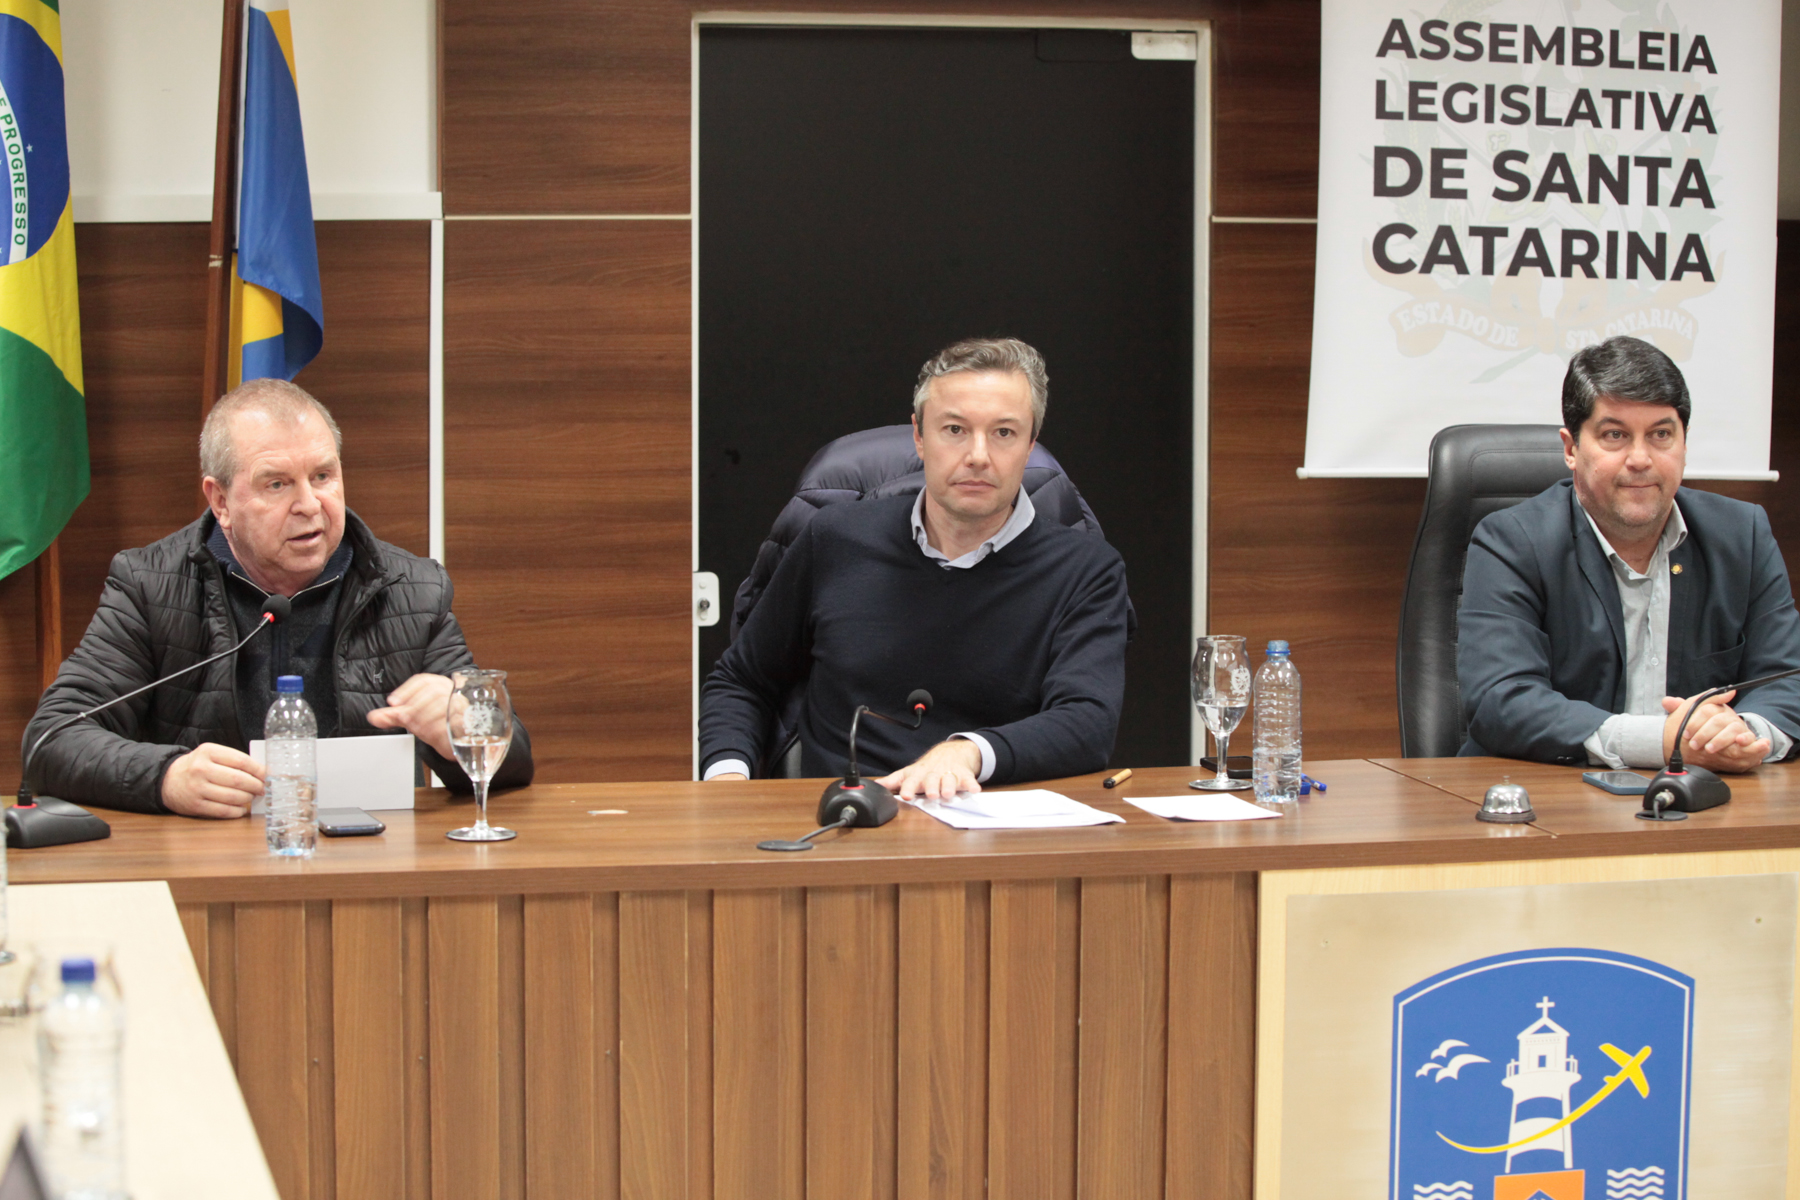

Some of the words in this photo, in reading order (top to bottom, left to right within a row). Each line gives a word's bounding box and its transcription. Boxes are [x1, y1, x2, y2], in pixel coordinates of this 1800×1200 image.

[1376, 18, 1718, 74] ASSEMBLEIA
[1375, 79, 1718, 134] LEGISLATIVA
[0, 113, 26, 245] PROGRESSO
[1373, 146, 1468, 199] DE
[1492, 149, 1716, 209] SANTA
[1372, 223, 1715, 282] CATARINA
[1396, 301, 1489, 336] ESTADO
[1487, 322, 1519, 348] DE
[1605, 308, 1693, 340] CATARINA
